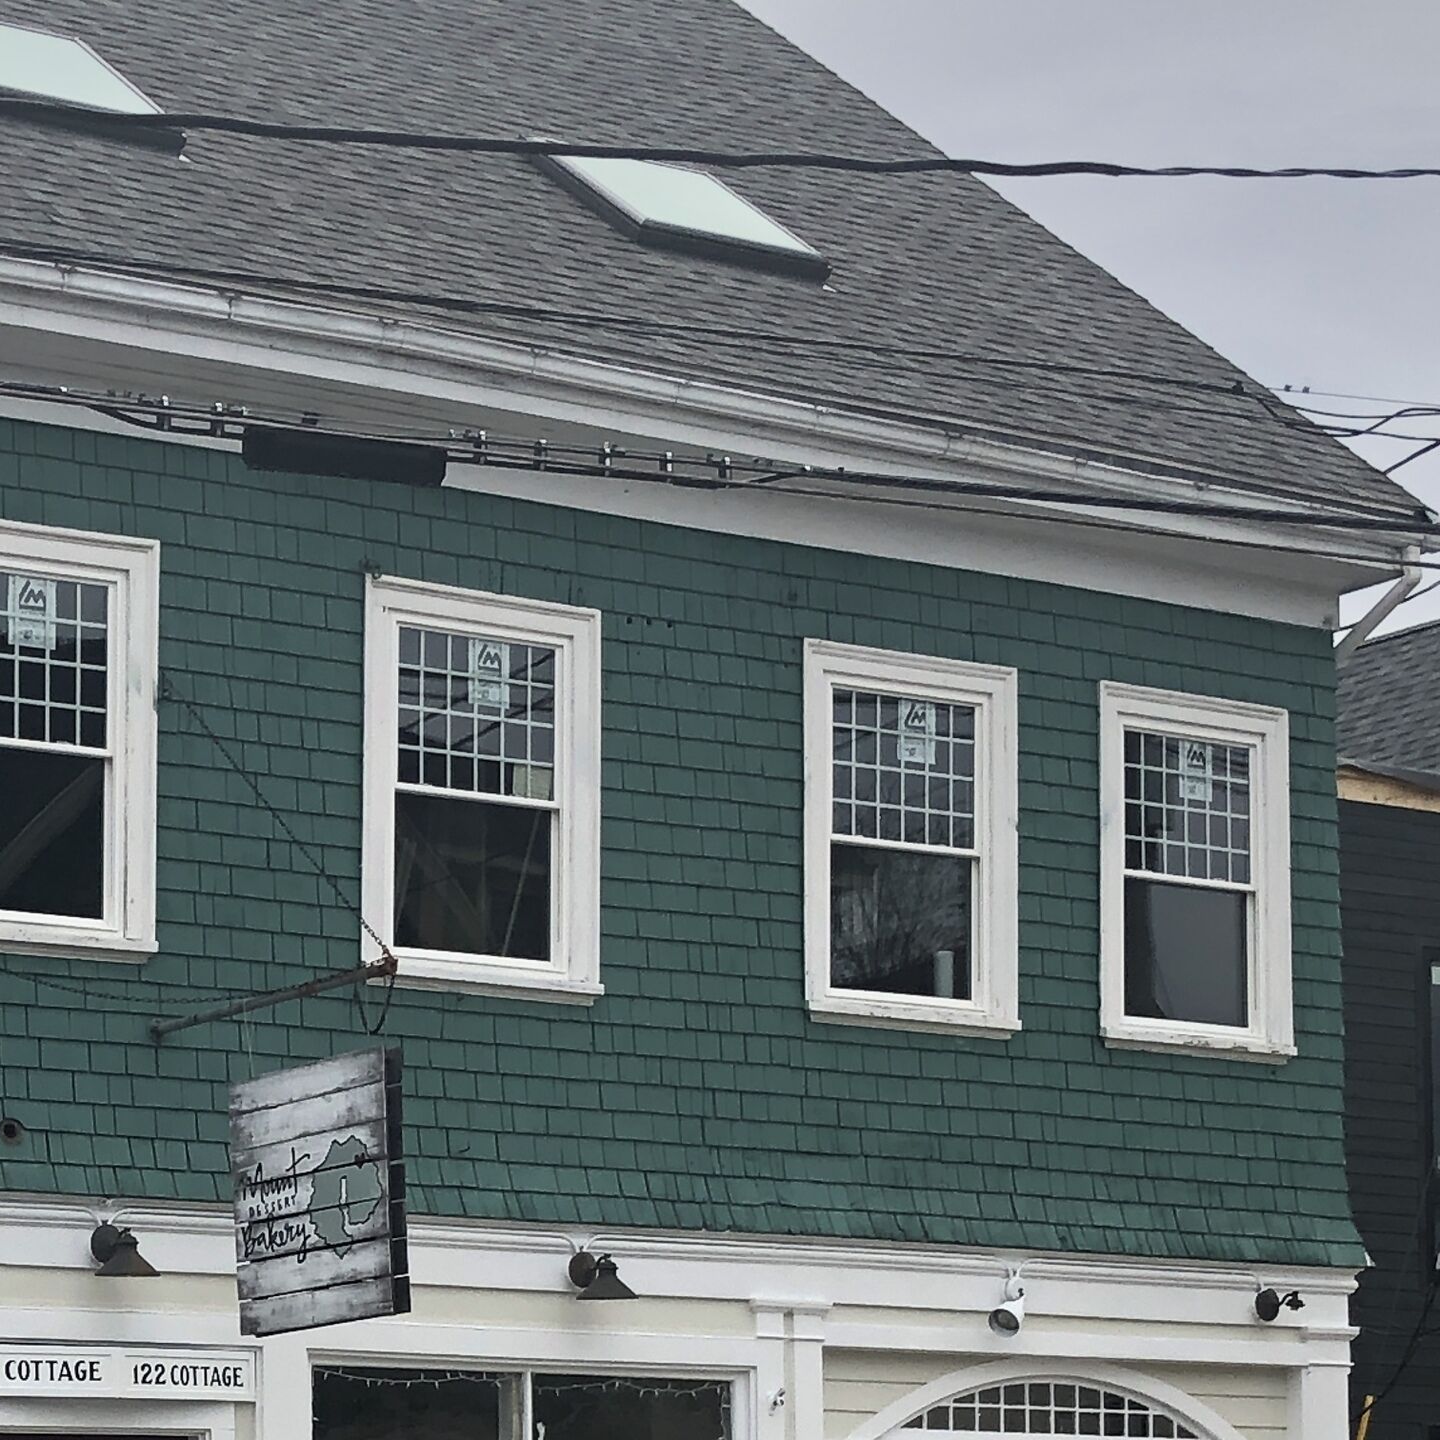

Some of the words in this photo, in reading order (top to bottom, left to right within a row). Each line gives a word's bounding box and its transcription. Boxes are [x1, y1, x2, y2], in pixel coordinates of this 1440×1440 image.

[242, 1146, 311, 1204] Mount
[248, 1196, 296, 1218] DESSERT
[240, 1213, 312, 1264] Bakery
[4, 1359, 102, 1382] COTTAGE
[133, 1363, 167, 1386] 122
[170, 1364, 244, 1388] COTTAGE
